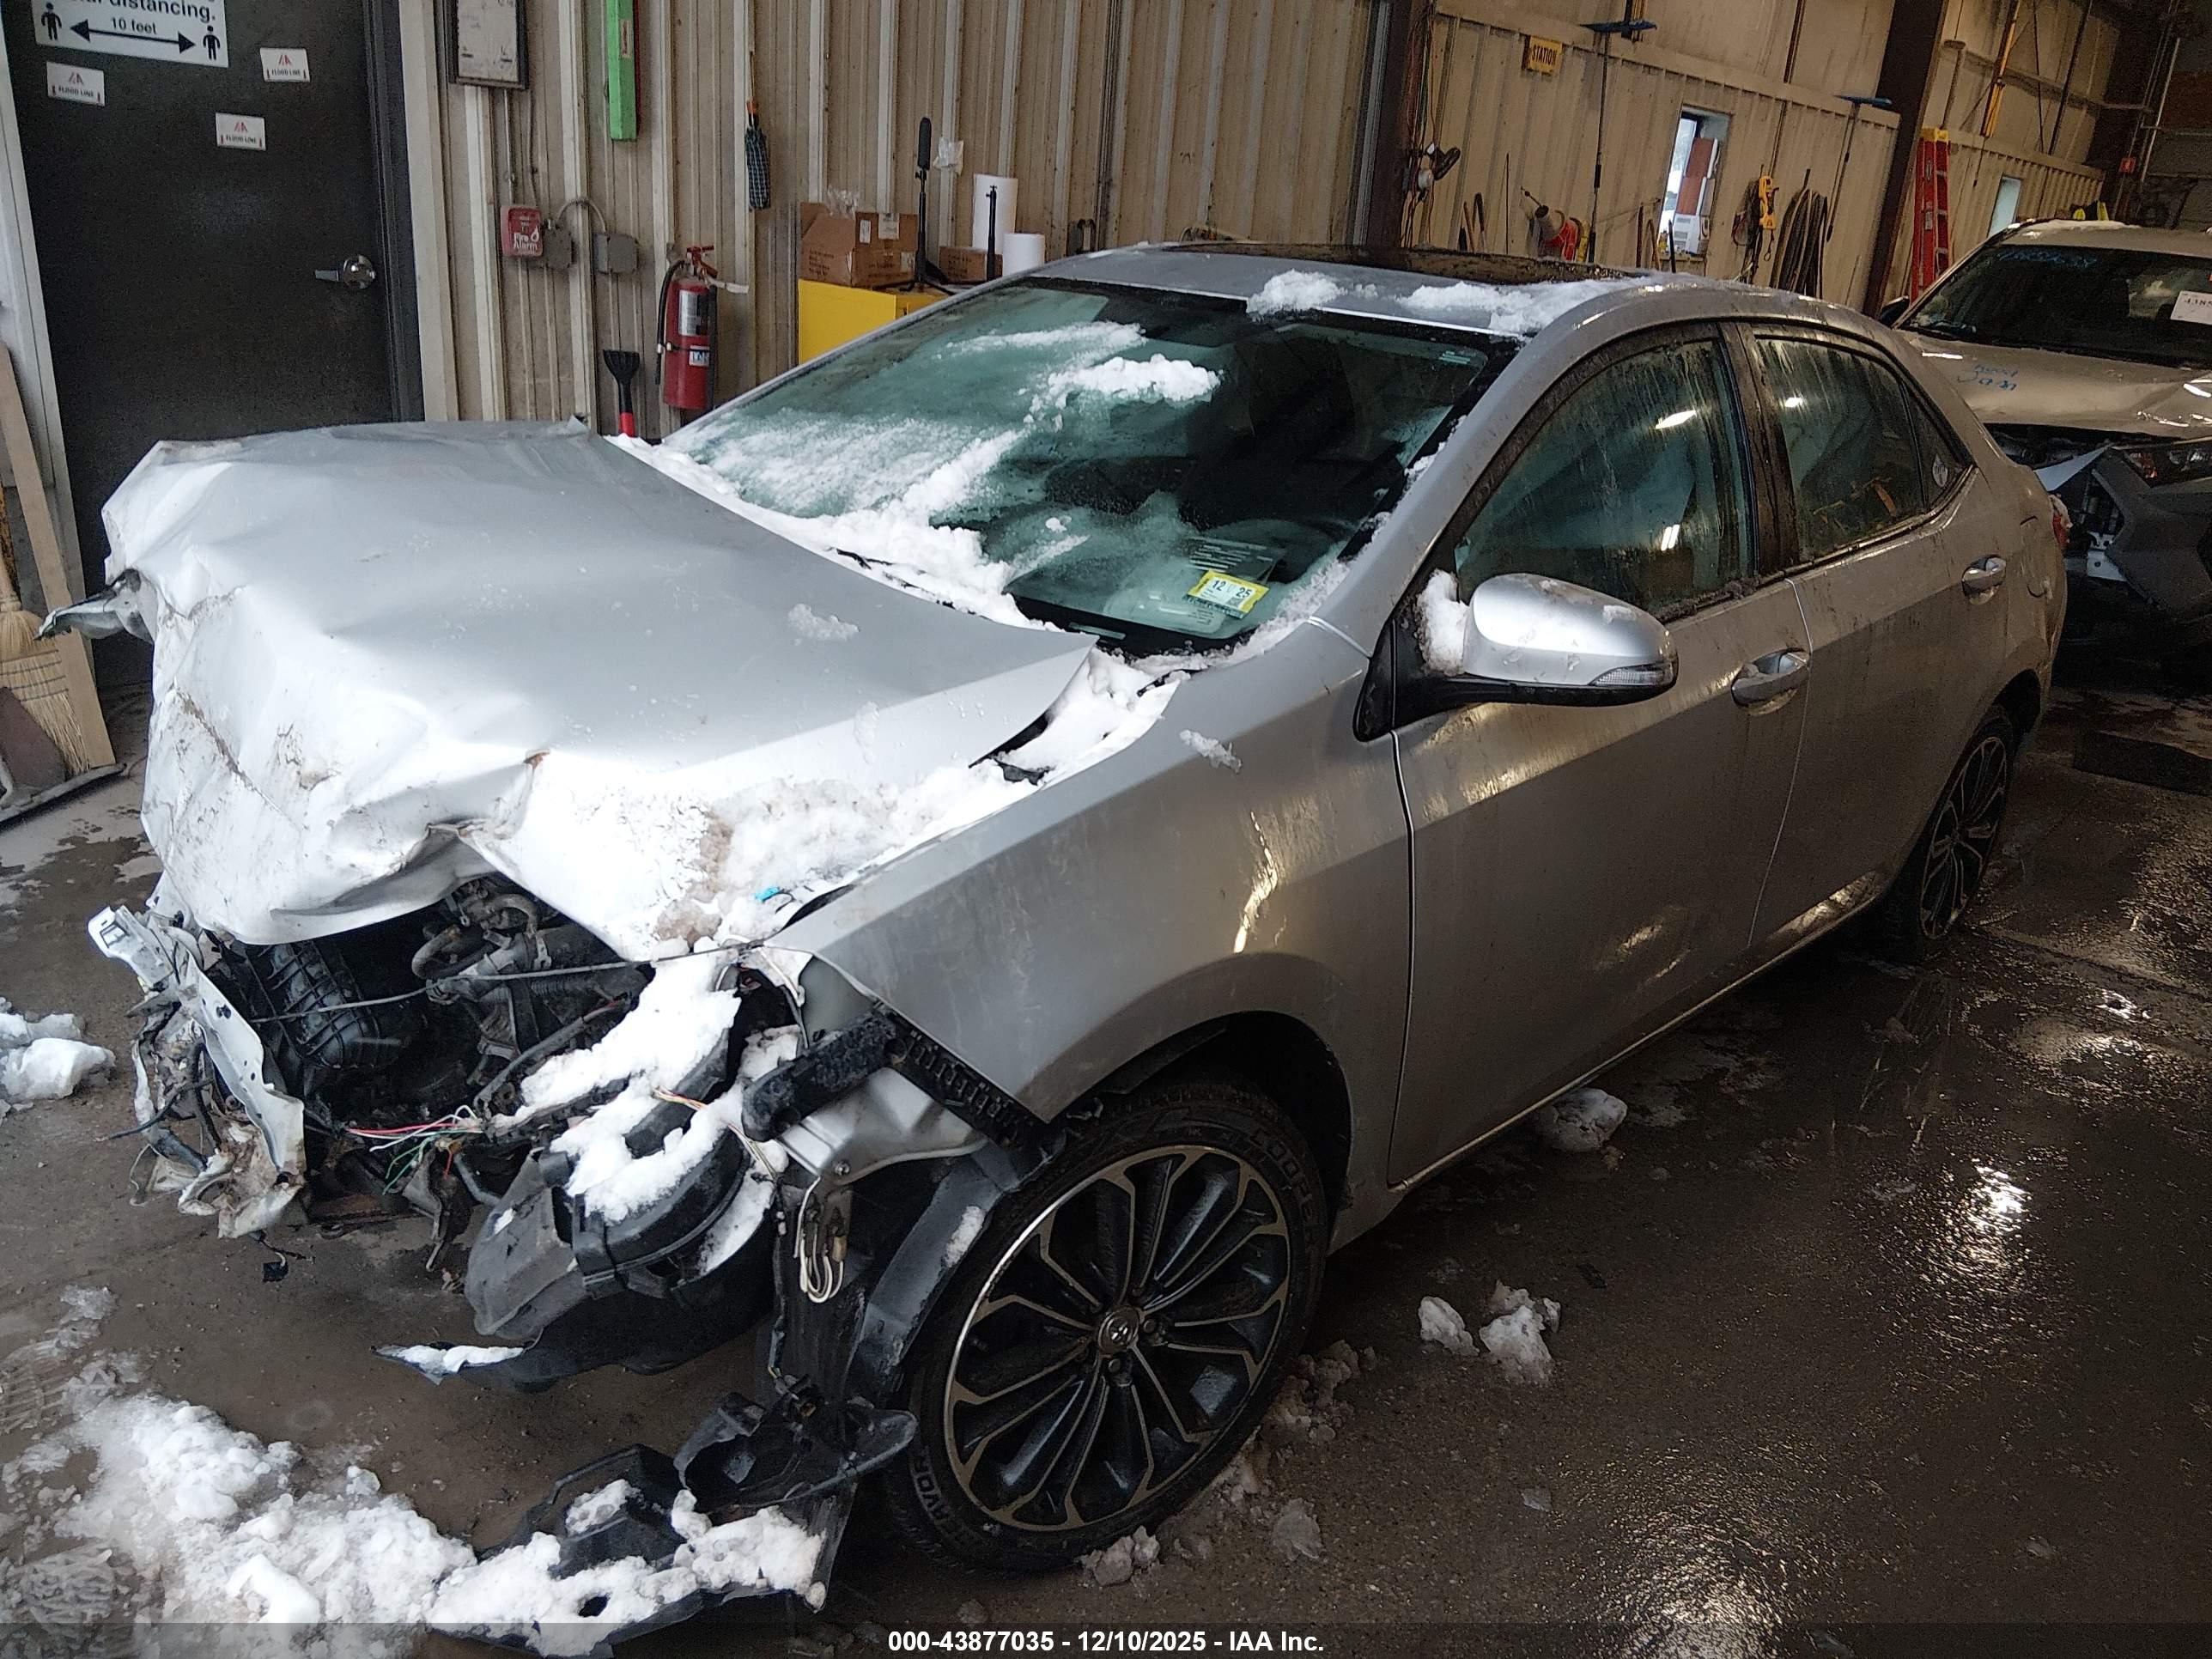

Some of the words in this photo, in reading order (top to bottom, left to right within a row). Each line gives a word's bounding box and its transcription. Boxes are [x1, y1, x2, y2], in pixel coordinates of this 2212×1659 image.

[111, 17, 127, 30] 10
[131, 19, 157, 35] feet
[1532, 45, 1557, 66] STATION
[514, 240, 538, 251] Alarm
[1212, 580, 1226, 592] 12
[1236, 586, 1253, 599] 25
